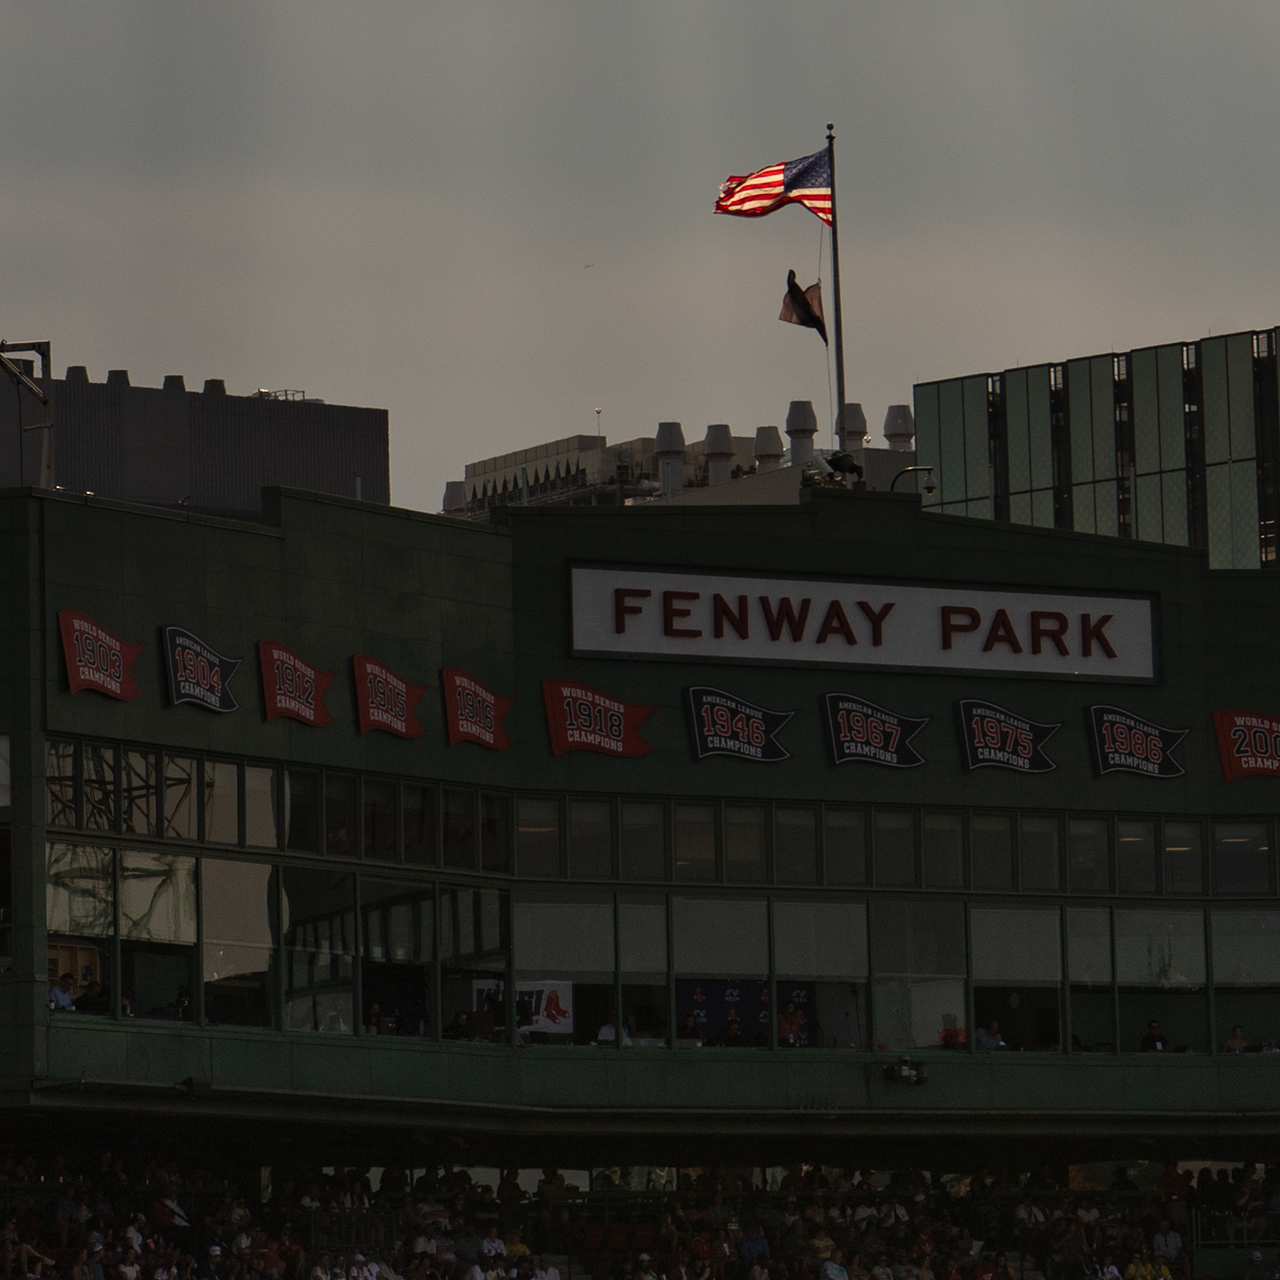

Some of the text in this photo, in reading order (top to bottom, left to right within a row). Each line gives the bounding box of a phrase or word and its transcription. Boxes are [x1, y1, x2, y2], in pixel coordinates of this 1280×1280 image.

[73, 619, 121, 651] WORLD SERIES
[613, 587, 1118, 659] FENWAY PARK
[73, 631, 123, 682] 1903
[272, 649, 315, 679] WORLD SERIES
[80, 666, 121, 694] CHAMPIONS
[175, 647, 222, 697] 1904
[274, 661, 315, 709] 1912
[365, 663, 406, 692] WORLD SERIES
[180, 681, 220, 707] CHAMPIONS
[367, 675, 407, 720] 1915
[454, 676, 495, 704] WORLD SERIES
[561, 687, 625, 713] WORLD SERIES
[276, 695, 315, 721] CHAMPIONS
[369, 708, 406, 733] CHAMPIONS
[456, 688, 495, 732] 1916
[564, 698, 625, 740] 1918
[702, 695, 763, 719] AMERICAN LEAGUE
[838, 701, 899, 725] AMERICAN LEAGUE
[972, 708, 1031, 731] AMERICAN LEAGUE
[458, 720, 494, 744] CHAMPIONS
[701, 704, 766, 747] 1946
[837, 710, 901, 752] 1967
[971, 716, 1033, 758] 1975
[1103, 713, 1161, 736] AMERICAN LEAGUE
[1234, 717, 1271, 729] WORLD
[567, 730, 623, 752] CHAMPIONS
[707, 737, 763, 758] CHAMPIONS
[843, 742, 898, 763] CHAMPIONS
[1102, 722, 1163, 764] 1986
[977, 748, 1031, 769] CHAMPIONS
[1108, 753, 1160, 774] CHAMPIONS
